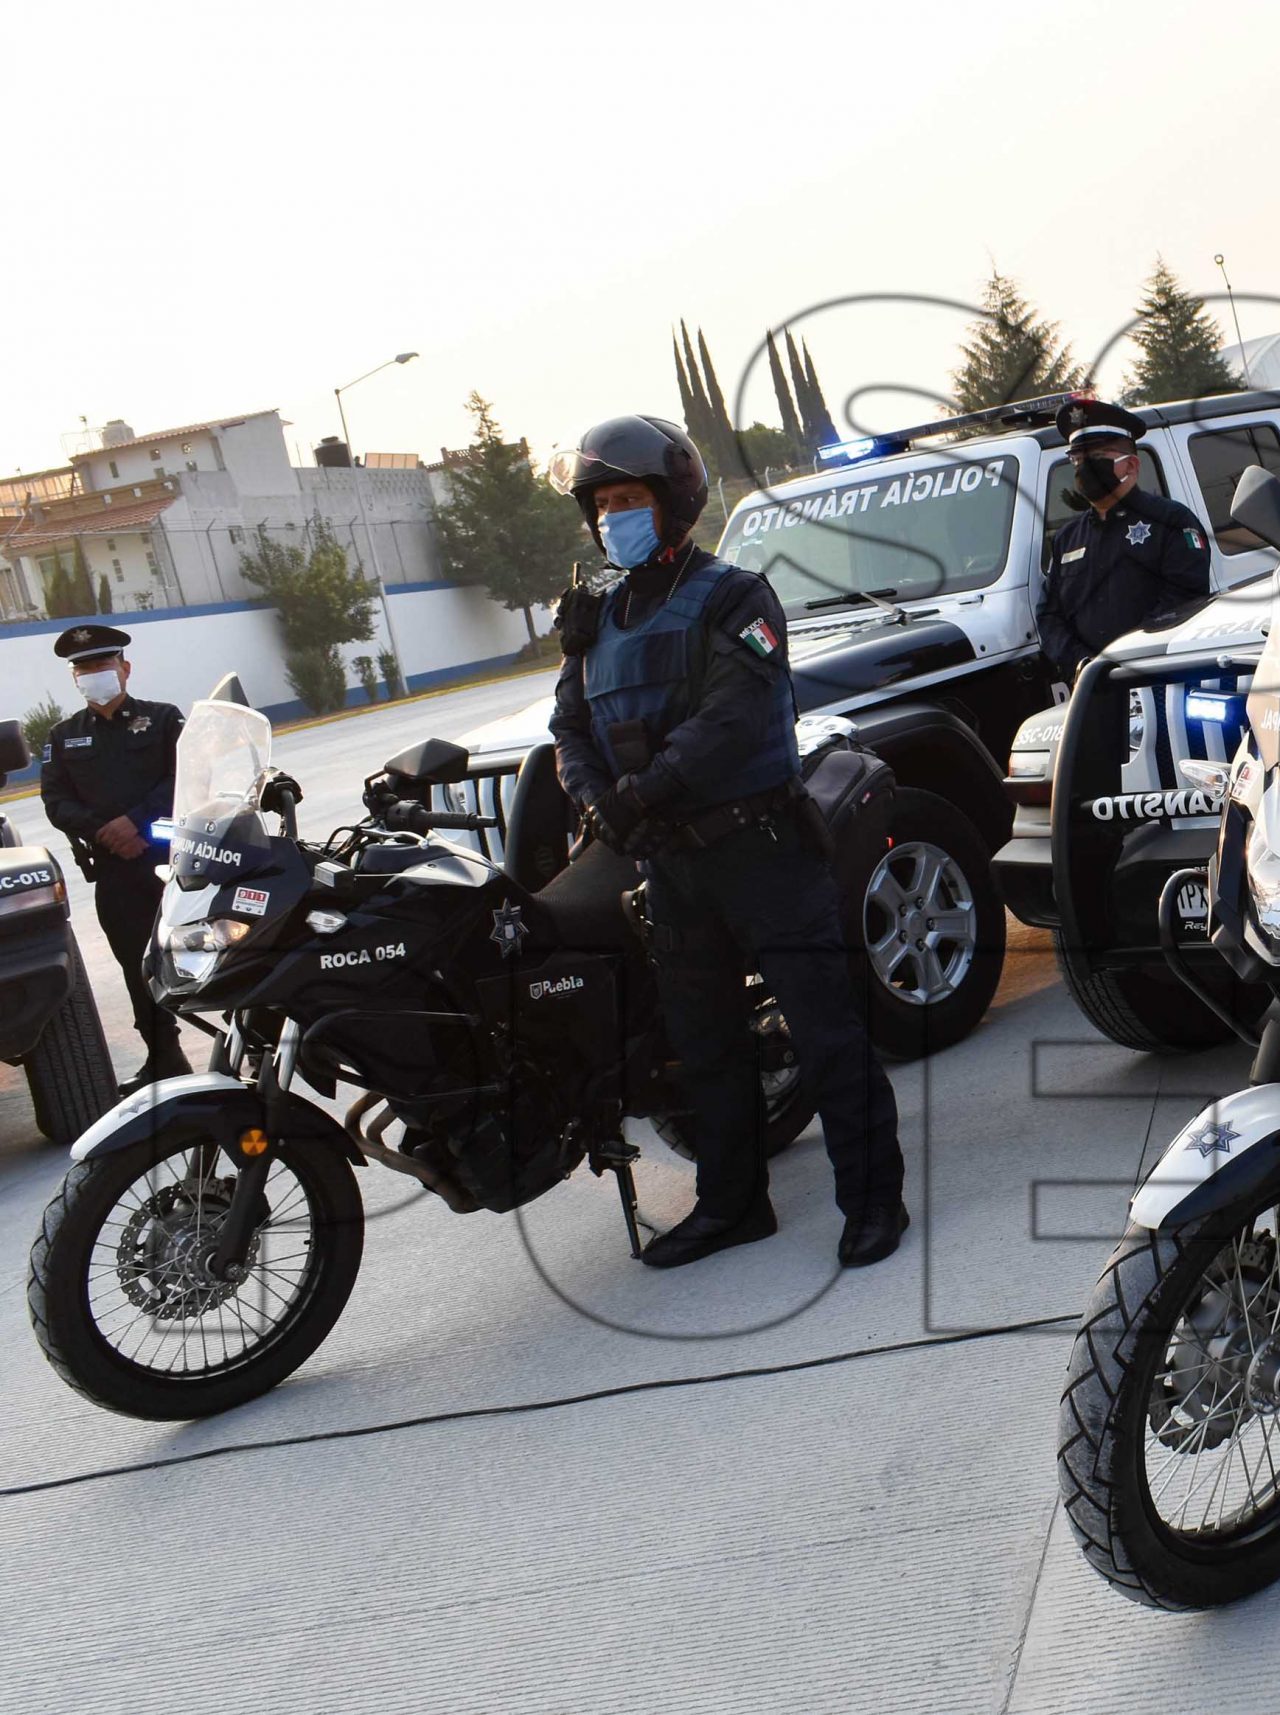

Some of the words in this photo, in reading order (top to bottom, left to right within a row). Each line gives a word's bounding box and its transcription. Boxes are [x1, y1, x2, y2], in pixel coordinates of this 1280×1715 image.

[320, 949, 372, 969] ROCA
[375, 942, 406, 961] 054
[542, 976, 584, 993] Puebla
